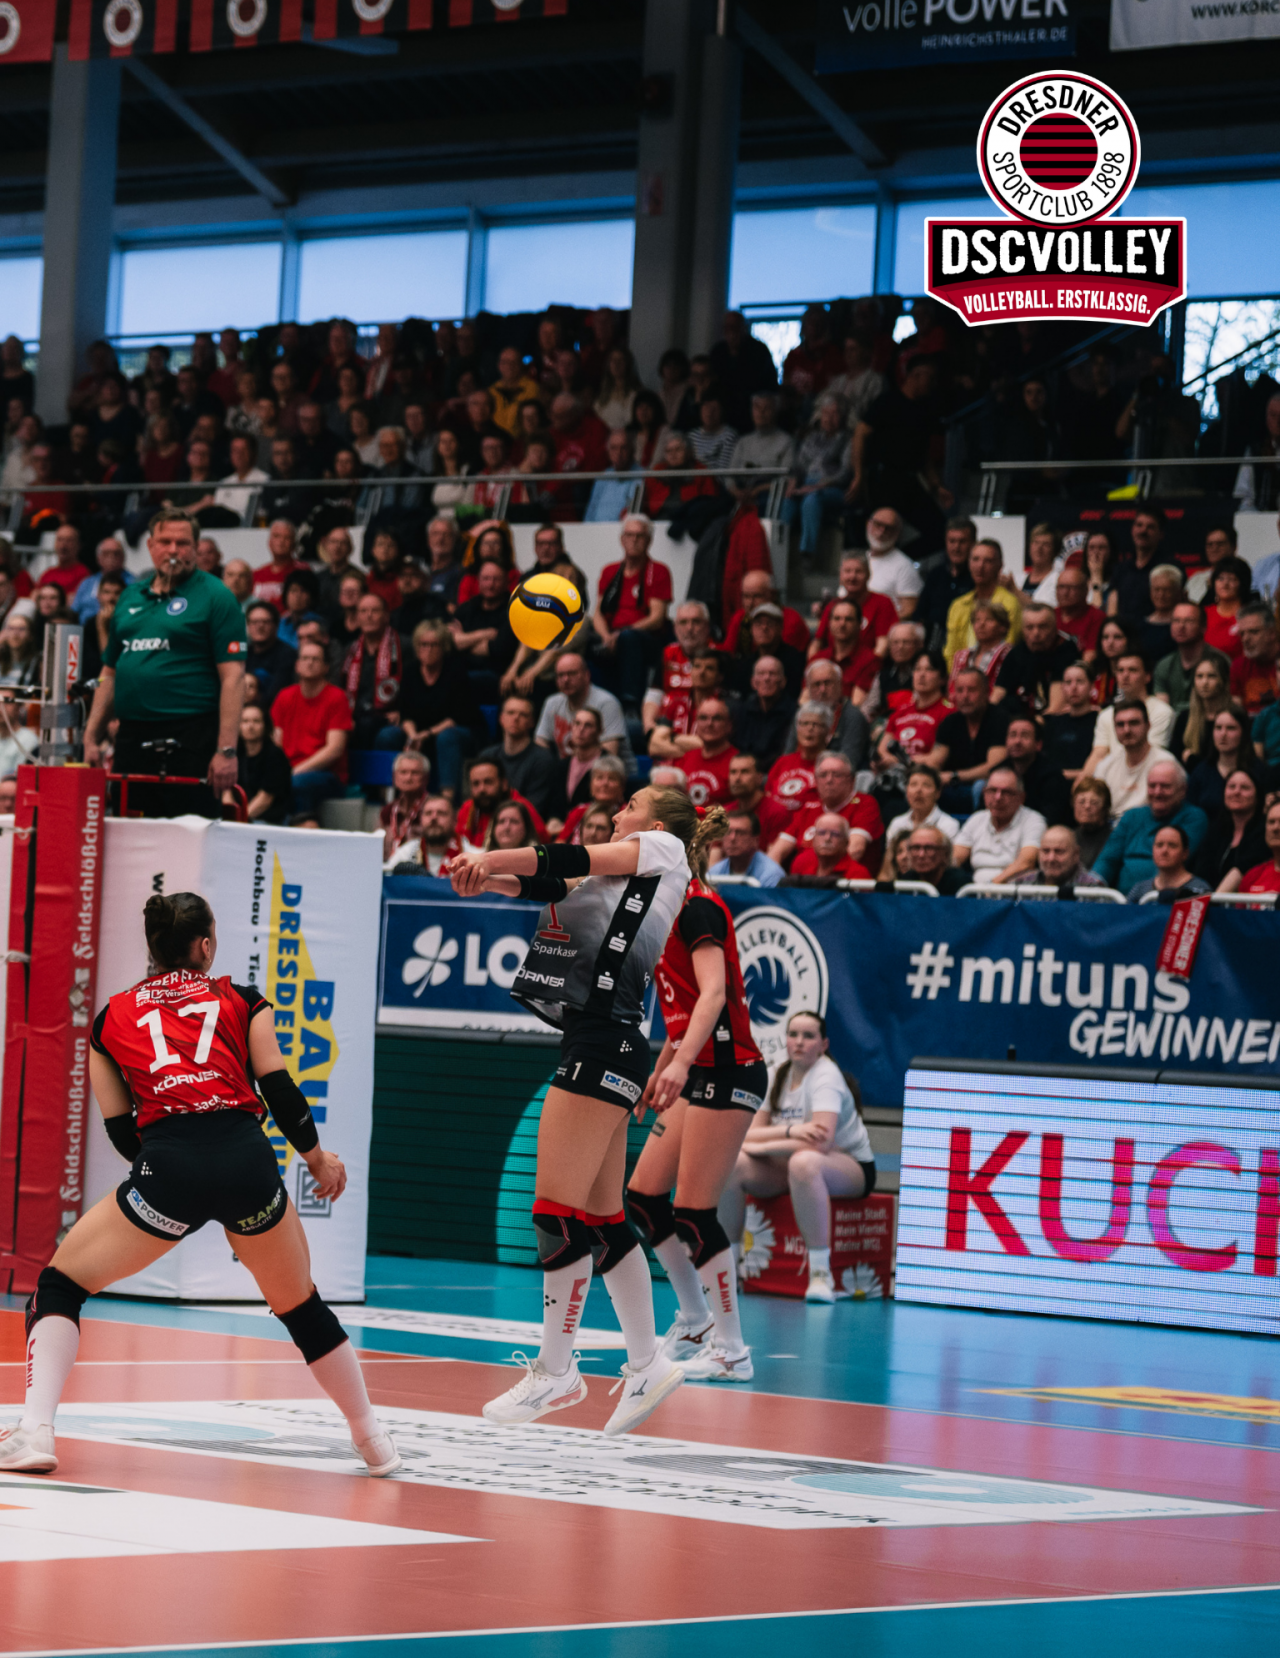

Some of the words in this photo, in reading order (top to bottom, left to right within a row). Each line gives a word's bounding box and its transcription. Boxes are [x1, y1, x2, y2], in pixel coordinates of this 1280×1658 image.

[131, 638, 170, 651] DEKRA
[251, 839, 268, 926] Hochbau
[274, 883, 302, 1057] DRESDEN
[517, 966, 565, 989] ÖRNER
[906, 941, 1191, 1014] #mituns
[136, 1000, 220, 1074] 17
[298, 979, 336, 1124] BAU
[1070, 1009, 1280, 1065] GEWINNE
[572, 1062, 582, 1081] 1
[704, 1083, 715, 1100] 5
[140, 1203, 185, 1232] POWER
